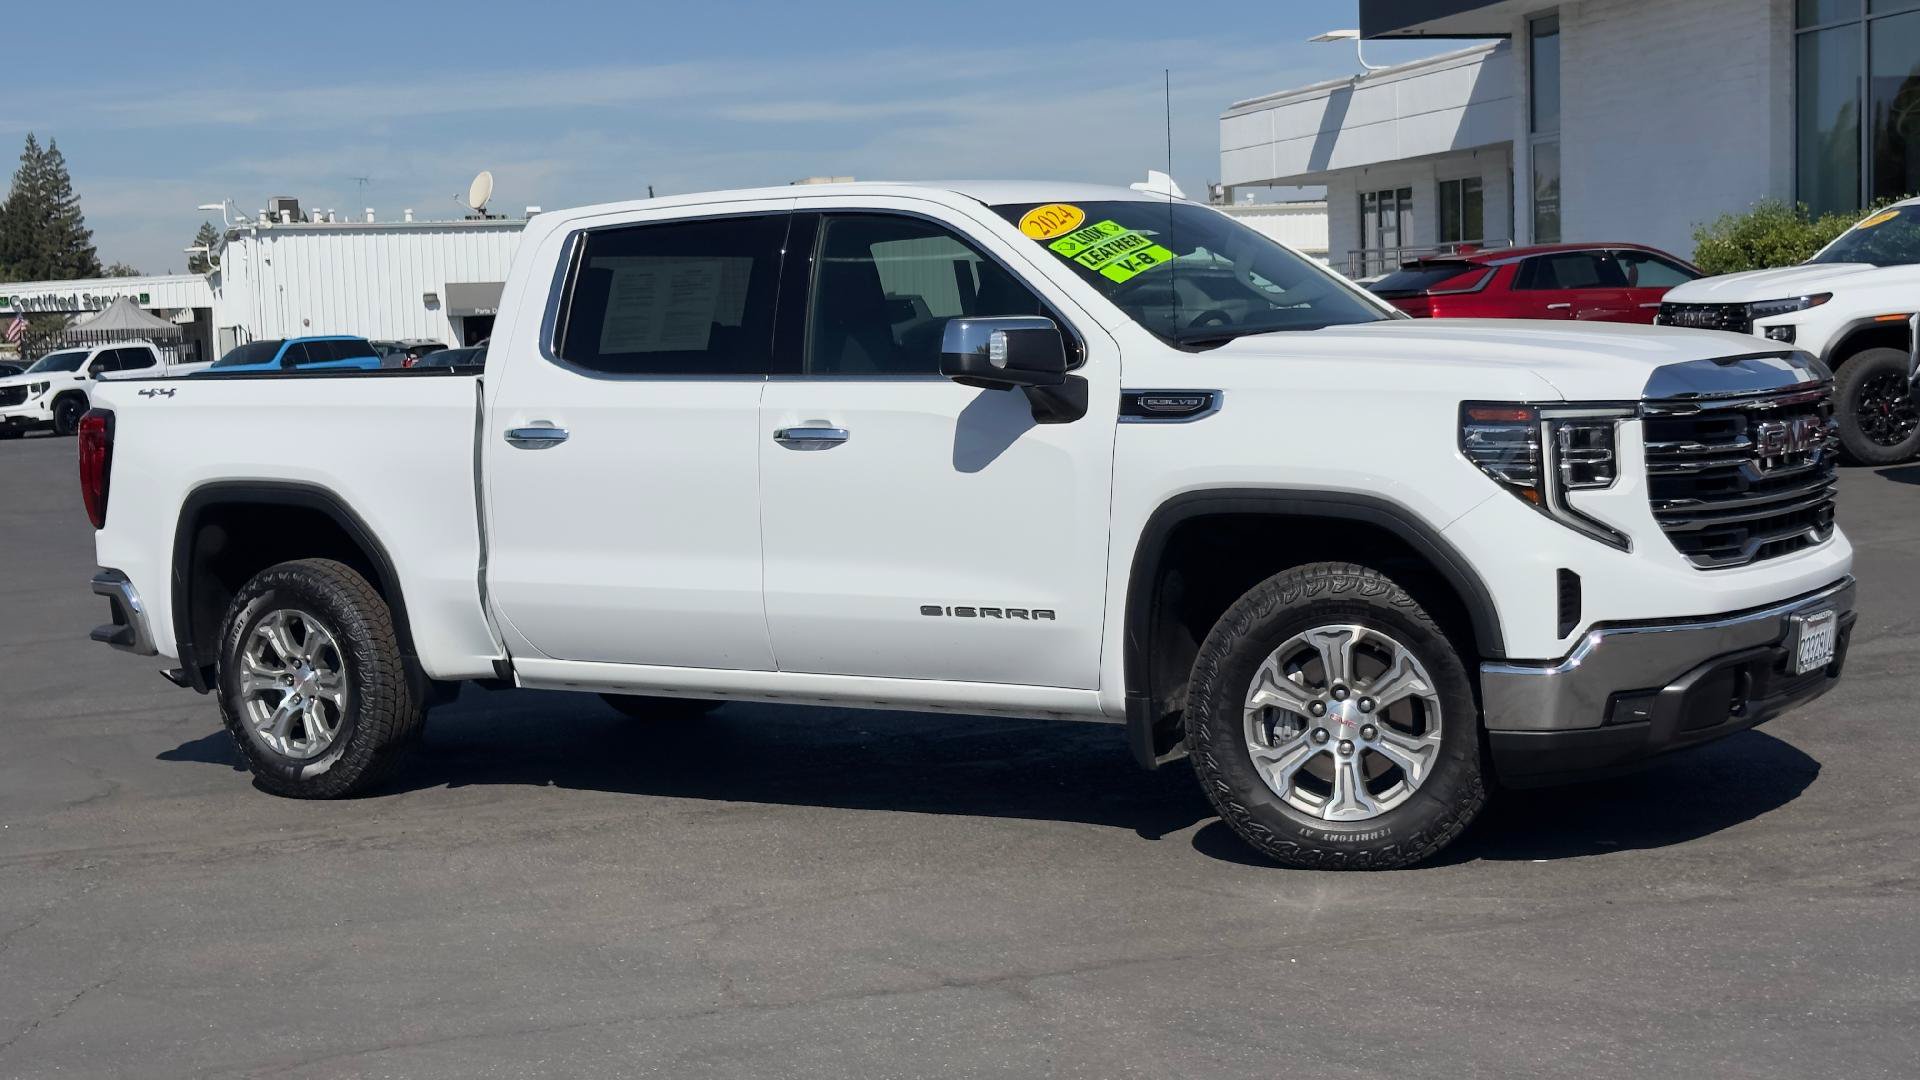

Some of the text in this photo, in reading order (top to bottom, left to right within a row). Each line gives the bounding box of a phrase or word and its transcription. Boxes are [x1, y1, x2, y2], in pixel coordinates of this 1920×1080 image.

[1029, 206, 1075, 236] 2024
[1080, 234, 1144, 267] LEATHER
[1117, 252, 1157, 273] V-8
[9, 292, 79, 312] Certified
[1757, 416, 1822, 457] GMC
[919, 604, 1057, 621] SIERRA
